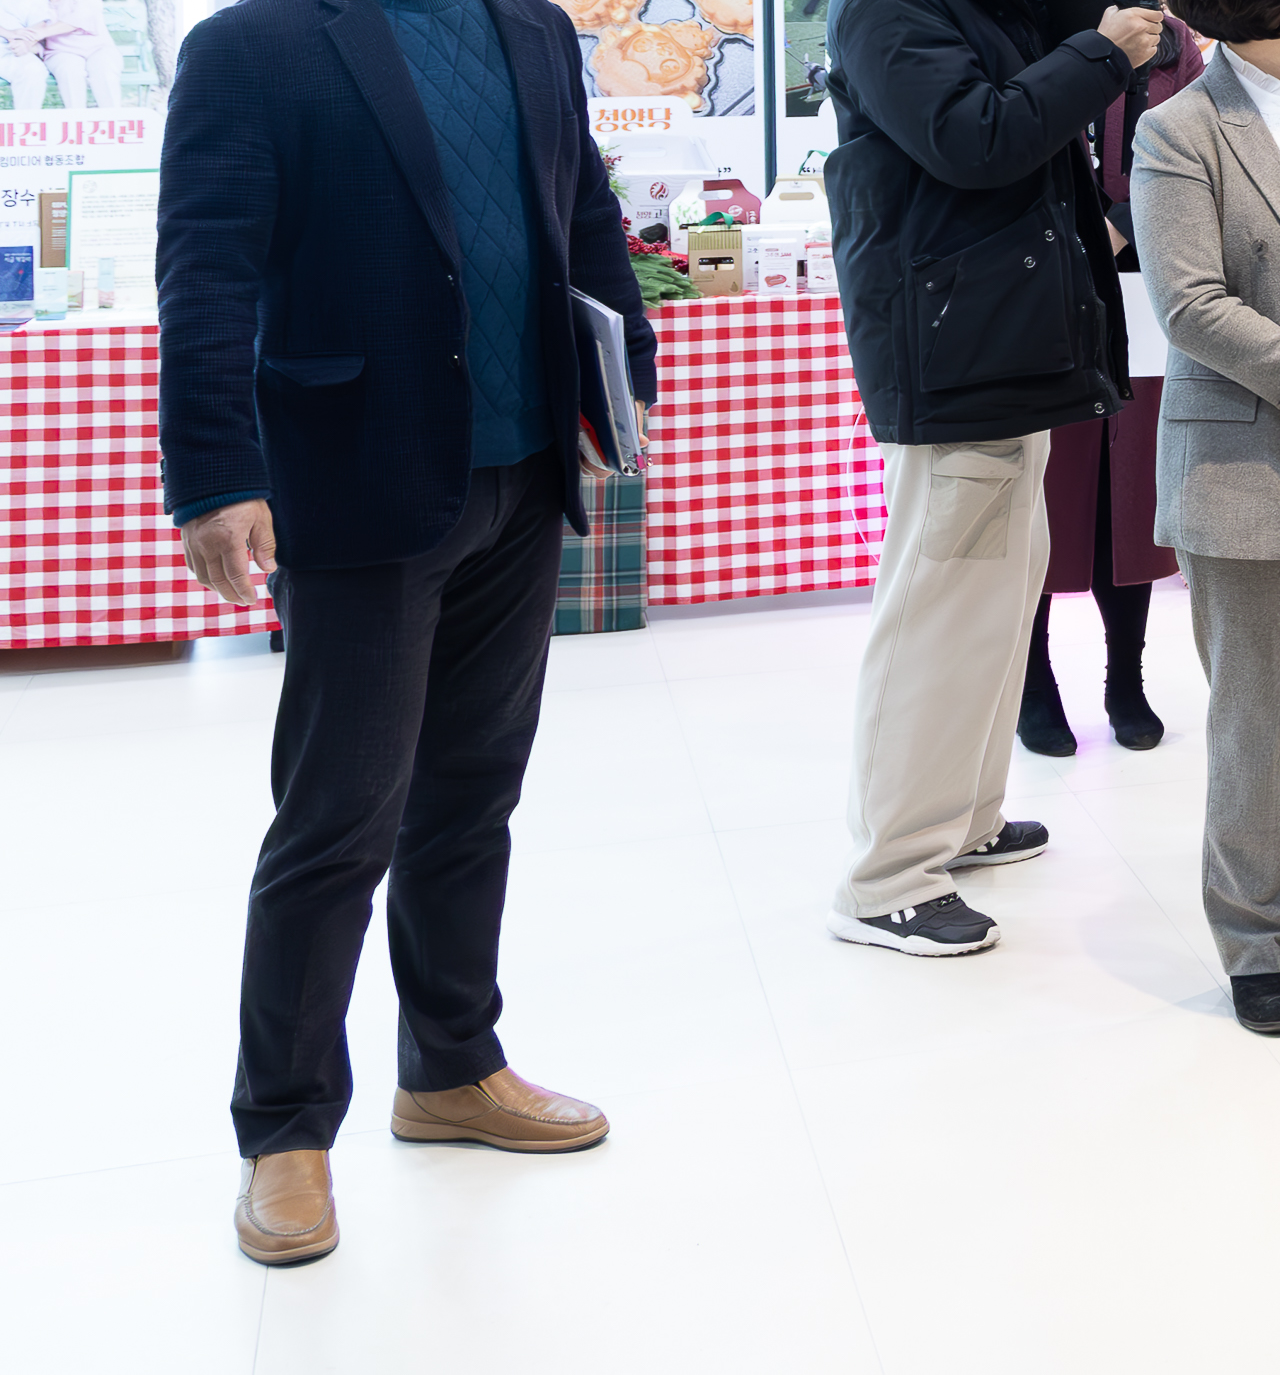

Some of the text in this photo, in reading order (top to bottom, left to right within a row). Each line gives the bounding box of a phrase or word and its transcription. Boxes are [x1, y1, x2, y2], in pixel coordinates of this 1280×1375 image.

[56, 119, 146, 145] 사진관
[593, 107, 672, 132] 청양당
[44, 154, 85, 167] 협동조합
